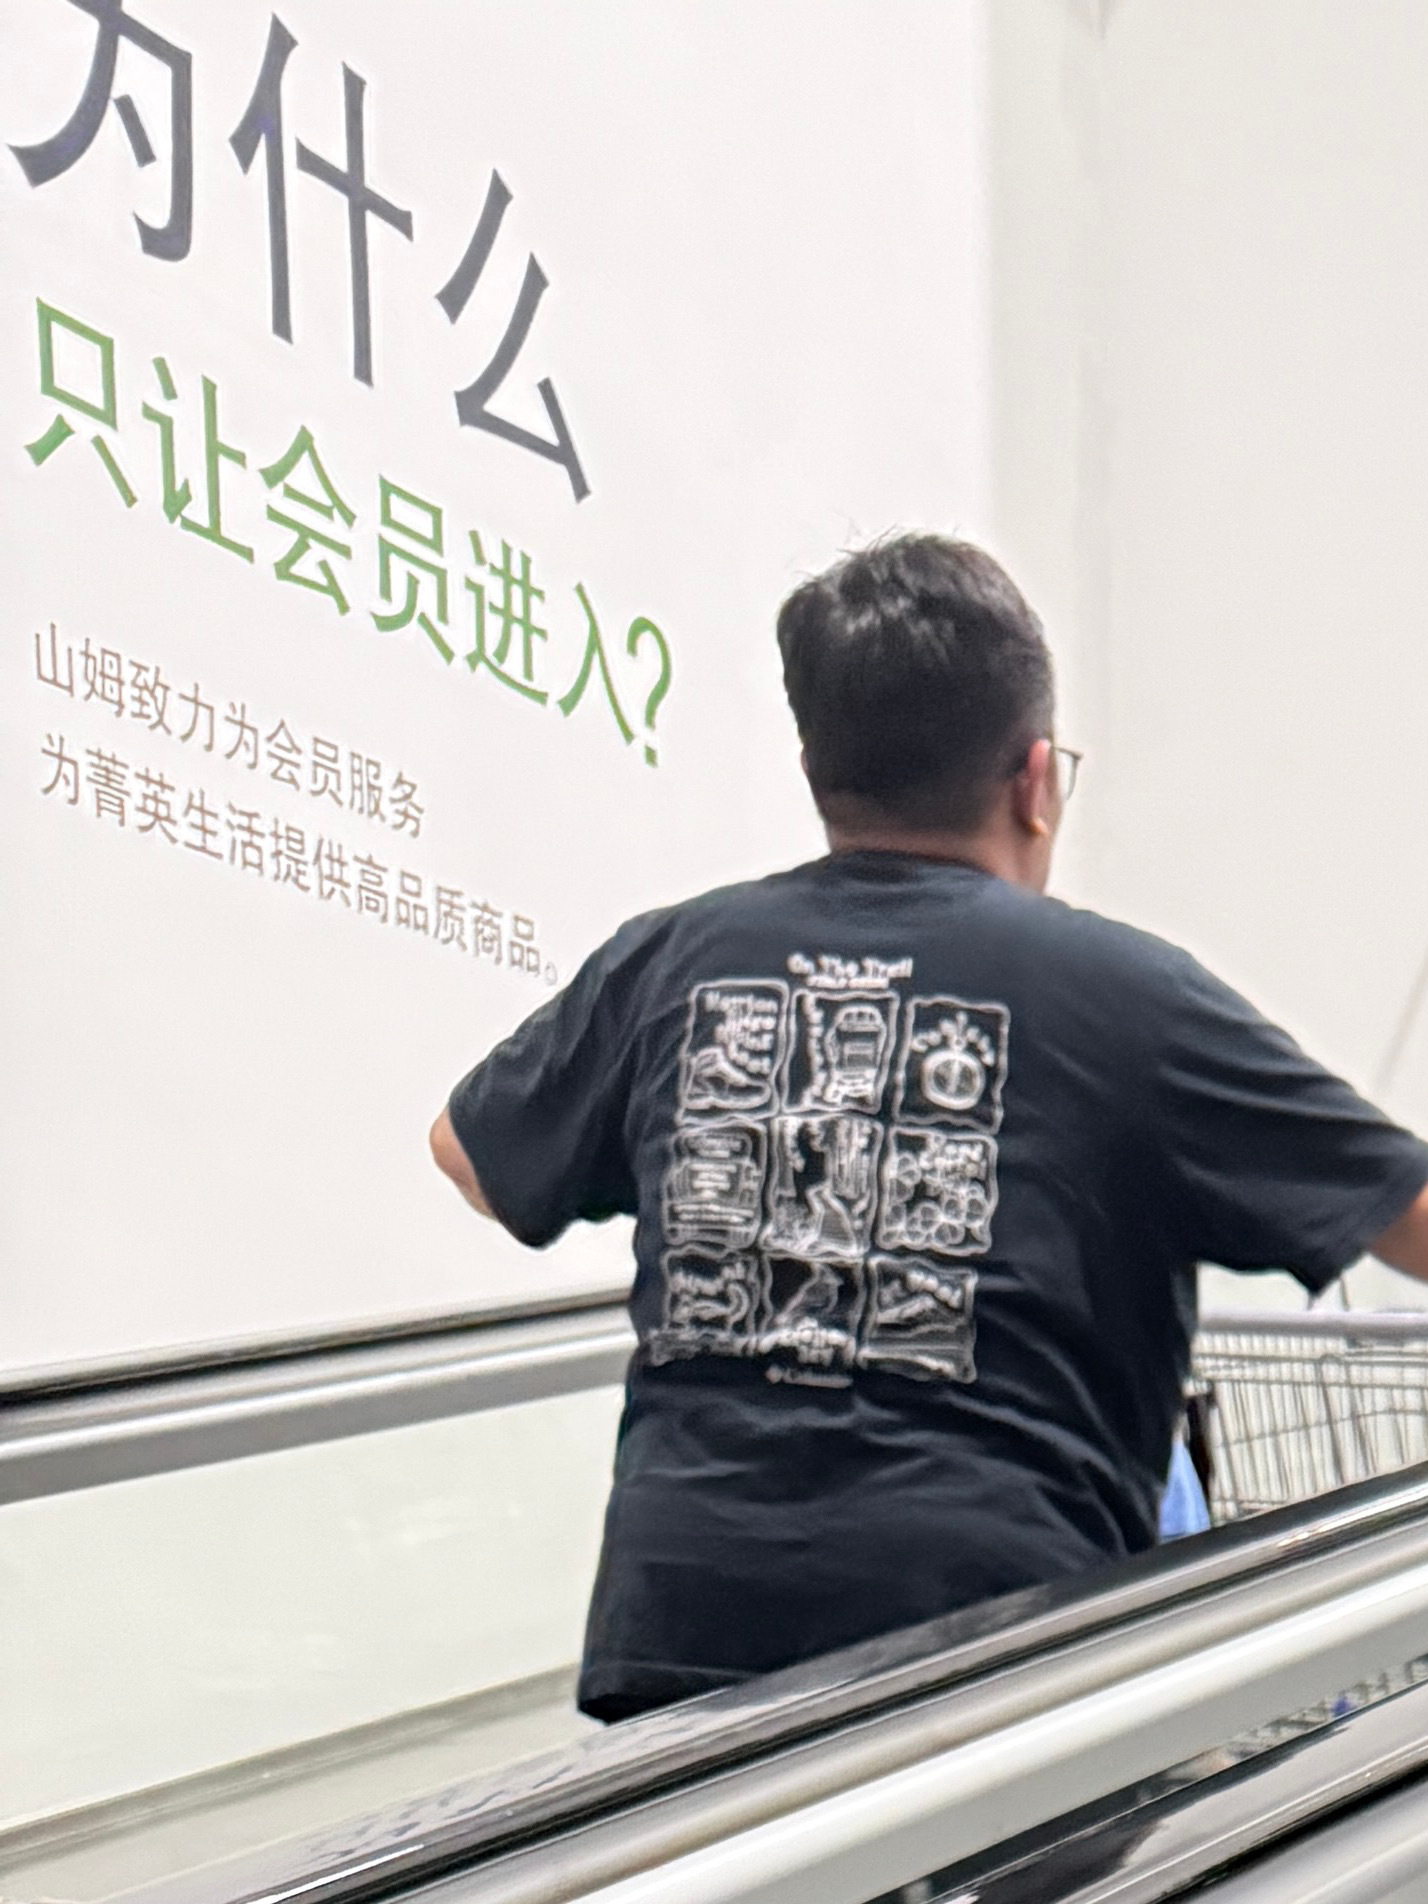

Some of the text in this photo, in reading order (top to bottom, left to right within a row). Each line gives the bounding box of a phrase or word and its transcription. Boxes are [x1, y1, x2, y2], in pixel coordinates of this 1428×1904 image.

[7, 0, 592, 503] 为什么
[33, 620, 426, 839] 山姆致力为会员服务
